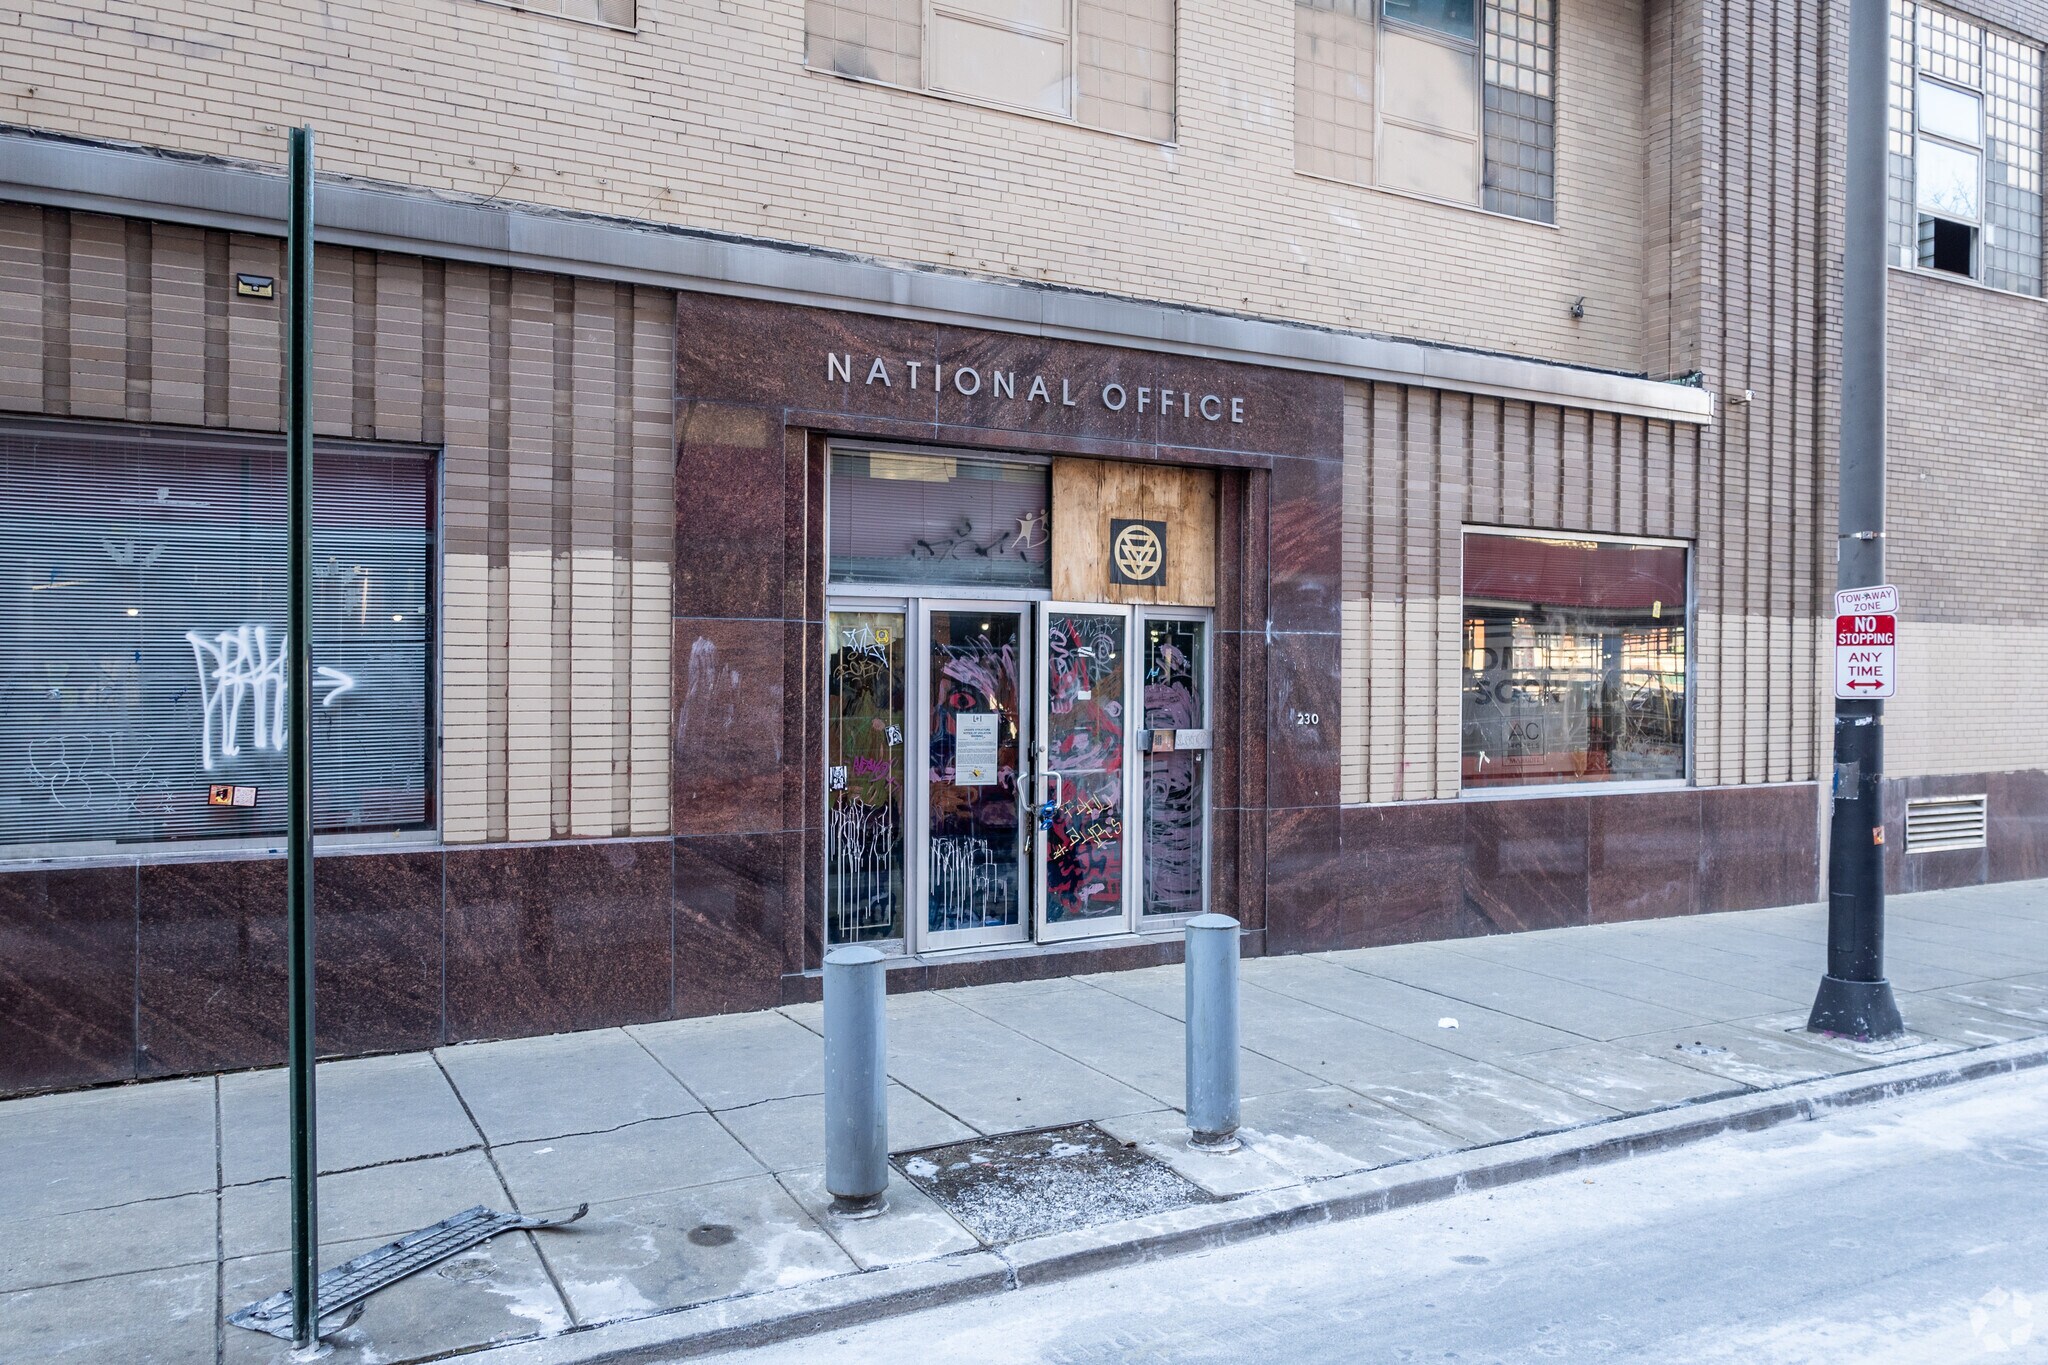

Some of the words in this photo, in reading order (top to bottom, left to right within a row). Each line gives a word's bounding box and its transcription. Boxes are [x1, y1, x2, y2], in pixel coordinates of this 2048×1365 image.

[828, 352, 1076, 406] NATIONAL
[1102, 382, 1244, 423] OFFICE
[1840, 591, 1892, 604] TOW-AWAY
[1854, 602, 1881, 611] ZONE
[1854, 616, 1877, 633] NO
[1838, 633, 1893, 645] STOPPING
[1848, 652, 1882, 663] ANY
[1848, 666, 1883, 677] TIME
[1297, 713, 1319, 725] 230
[1508, 722, 1539, 740] AC
